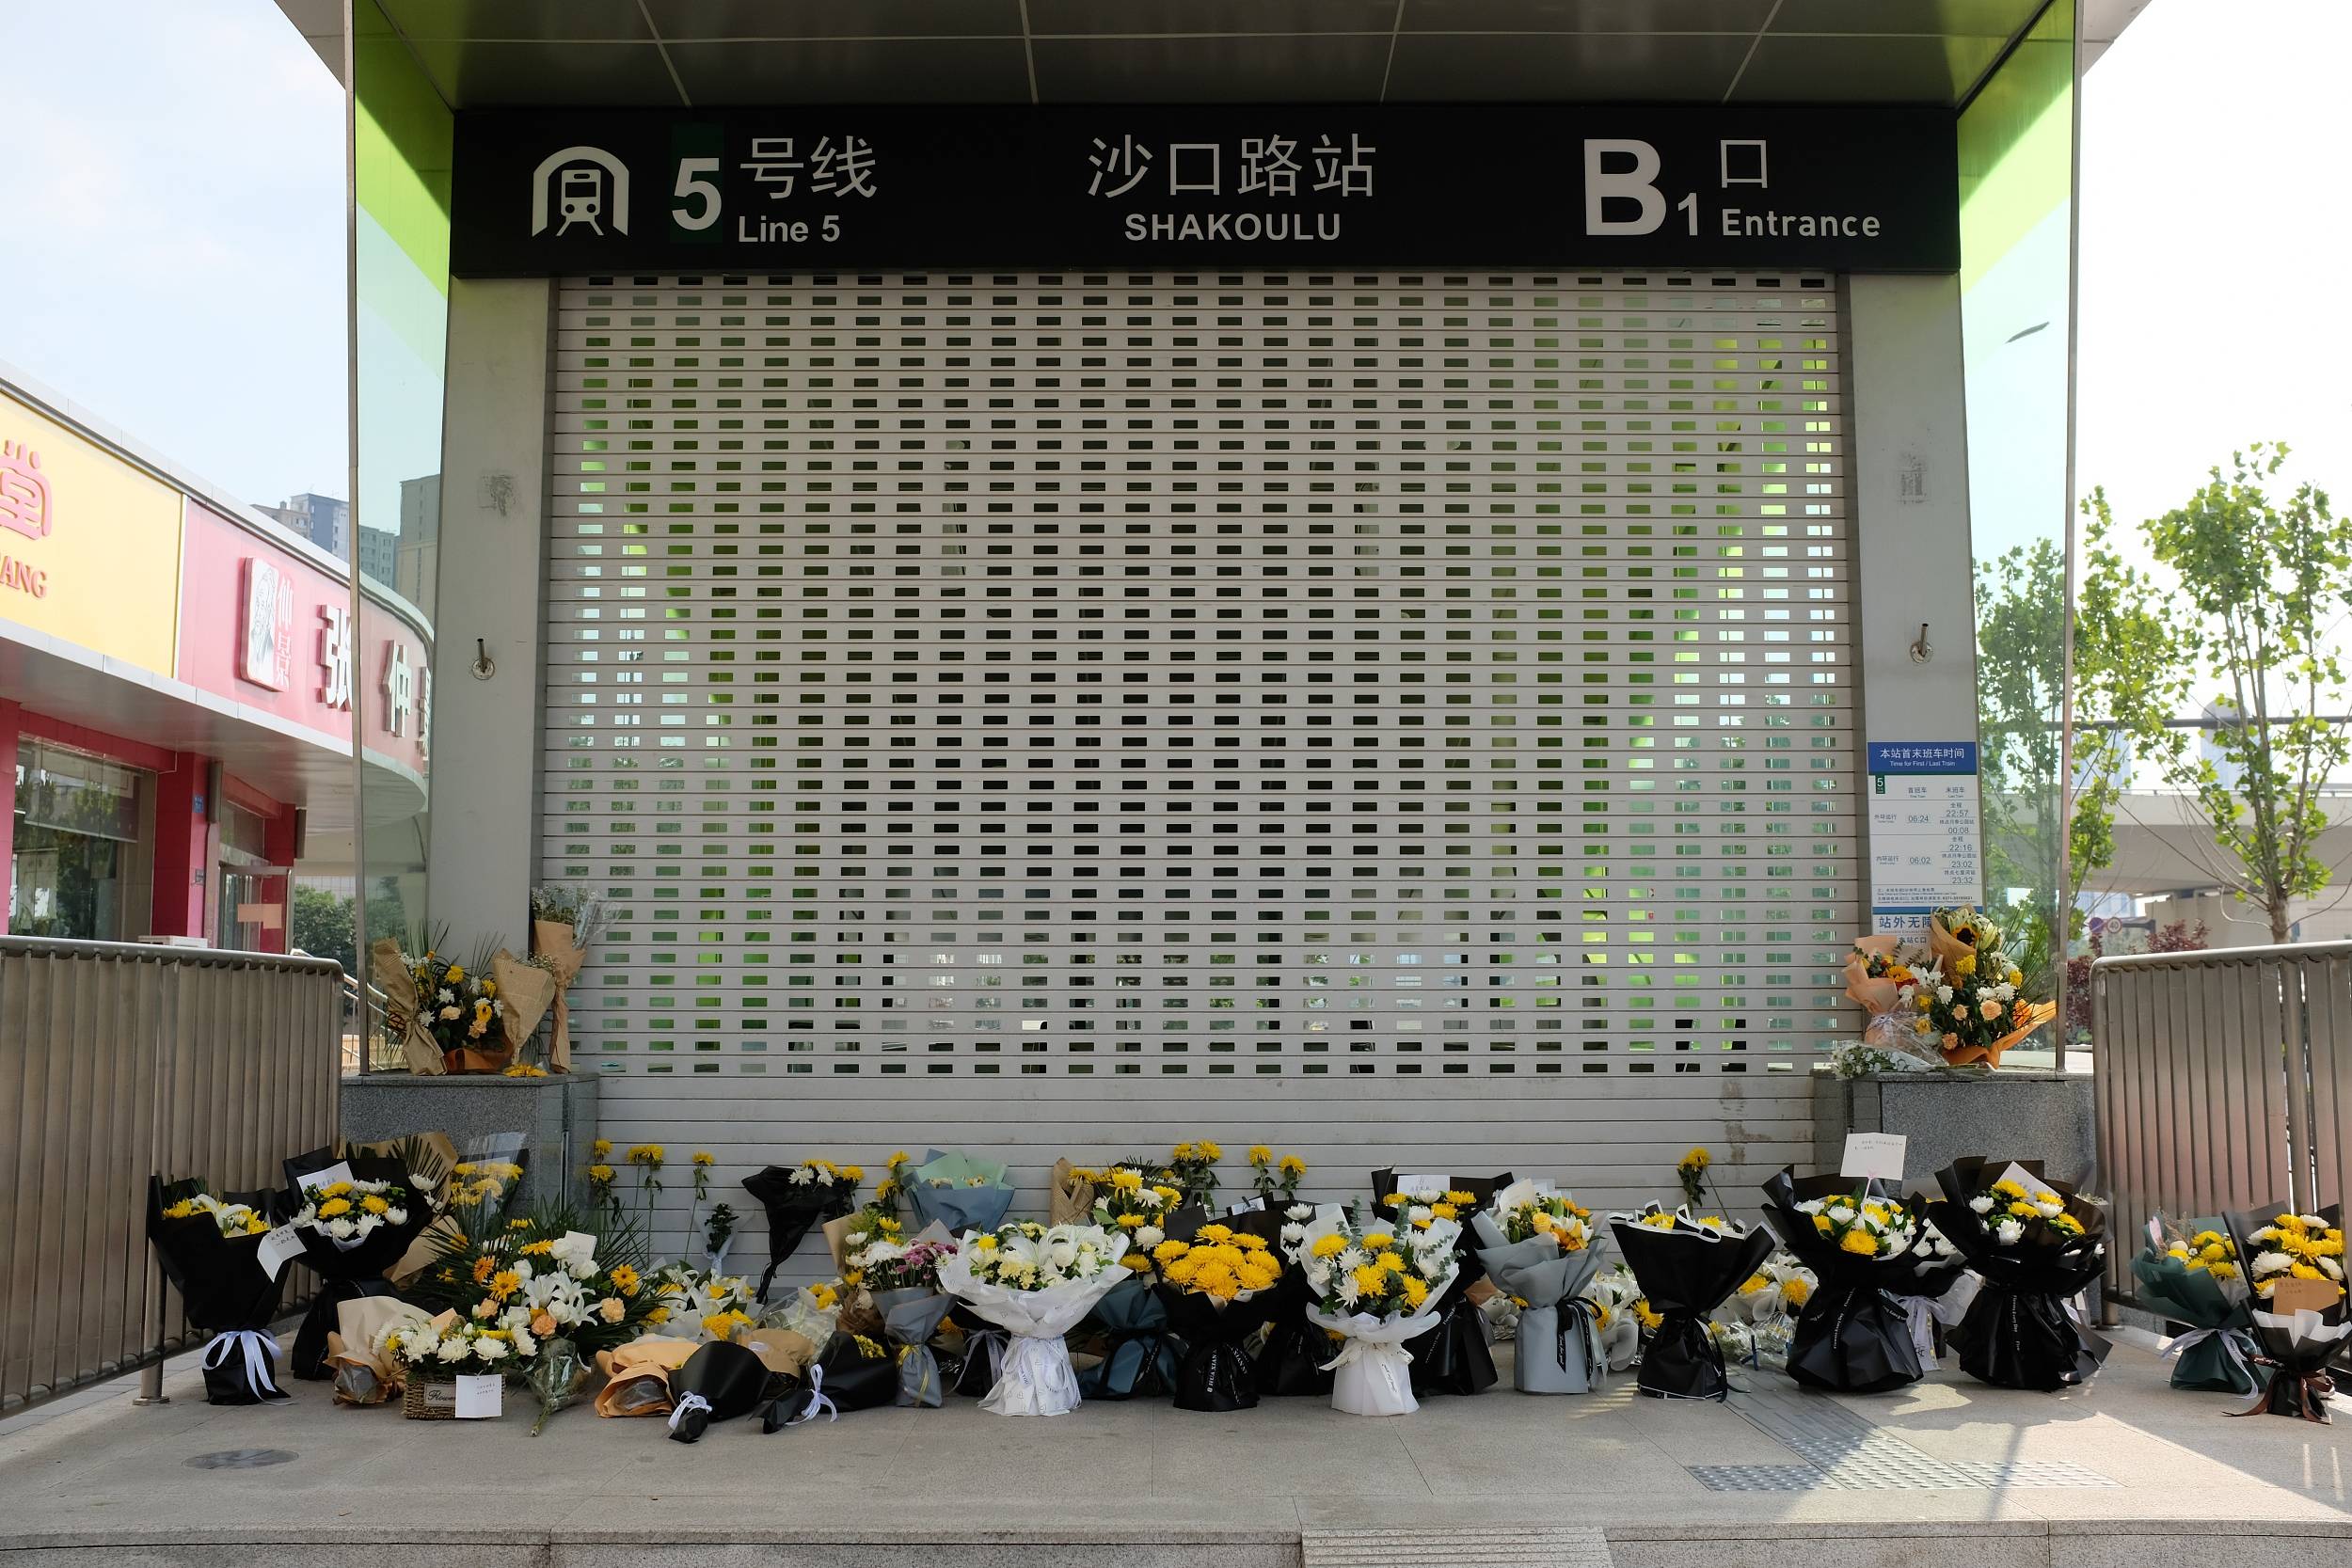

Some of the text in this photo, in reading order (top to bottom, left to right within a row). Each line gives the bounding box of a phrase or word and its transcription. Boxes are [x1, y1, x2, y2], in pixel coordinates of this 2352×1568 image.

[739, 135, 878, 199] 号线
[1088, 133, 1376, 198] 沙口路站
[1720, 139, 1768, 189] 口
[671, 157, 723, 231] 5
[739, 214, 841, 243] Line 5
[1124, 213, 1342, 242] SHAKOULU
[1722, 208, 1881, 237] Entrance
[0, 553, 47, 599] ANG
[1880, 748, 1964, 759] 本站首末班车时间
[1877, 778, 1883, 787] 5
